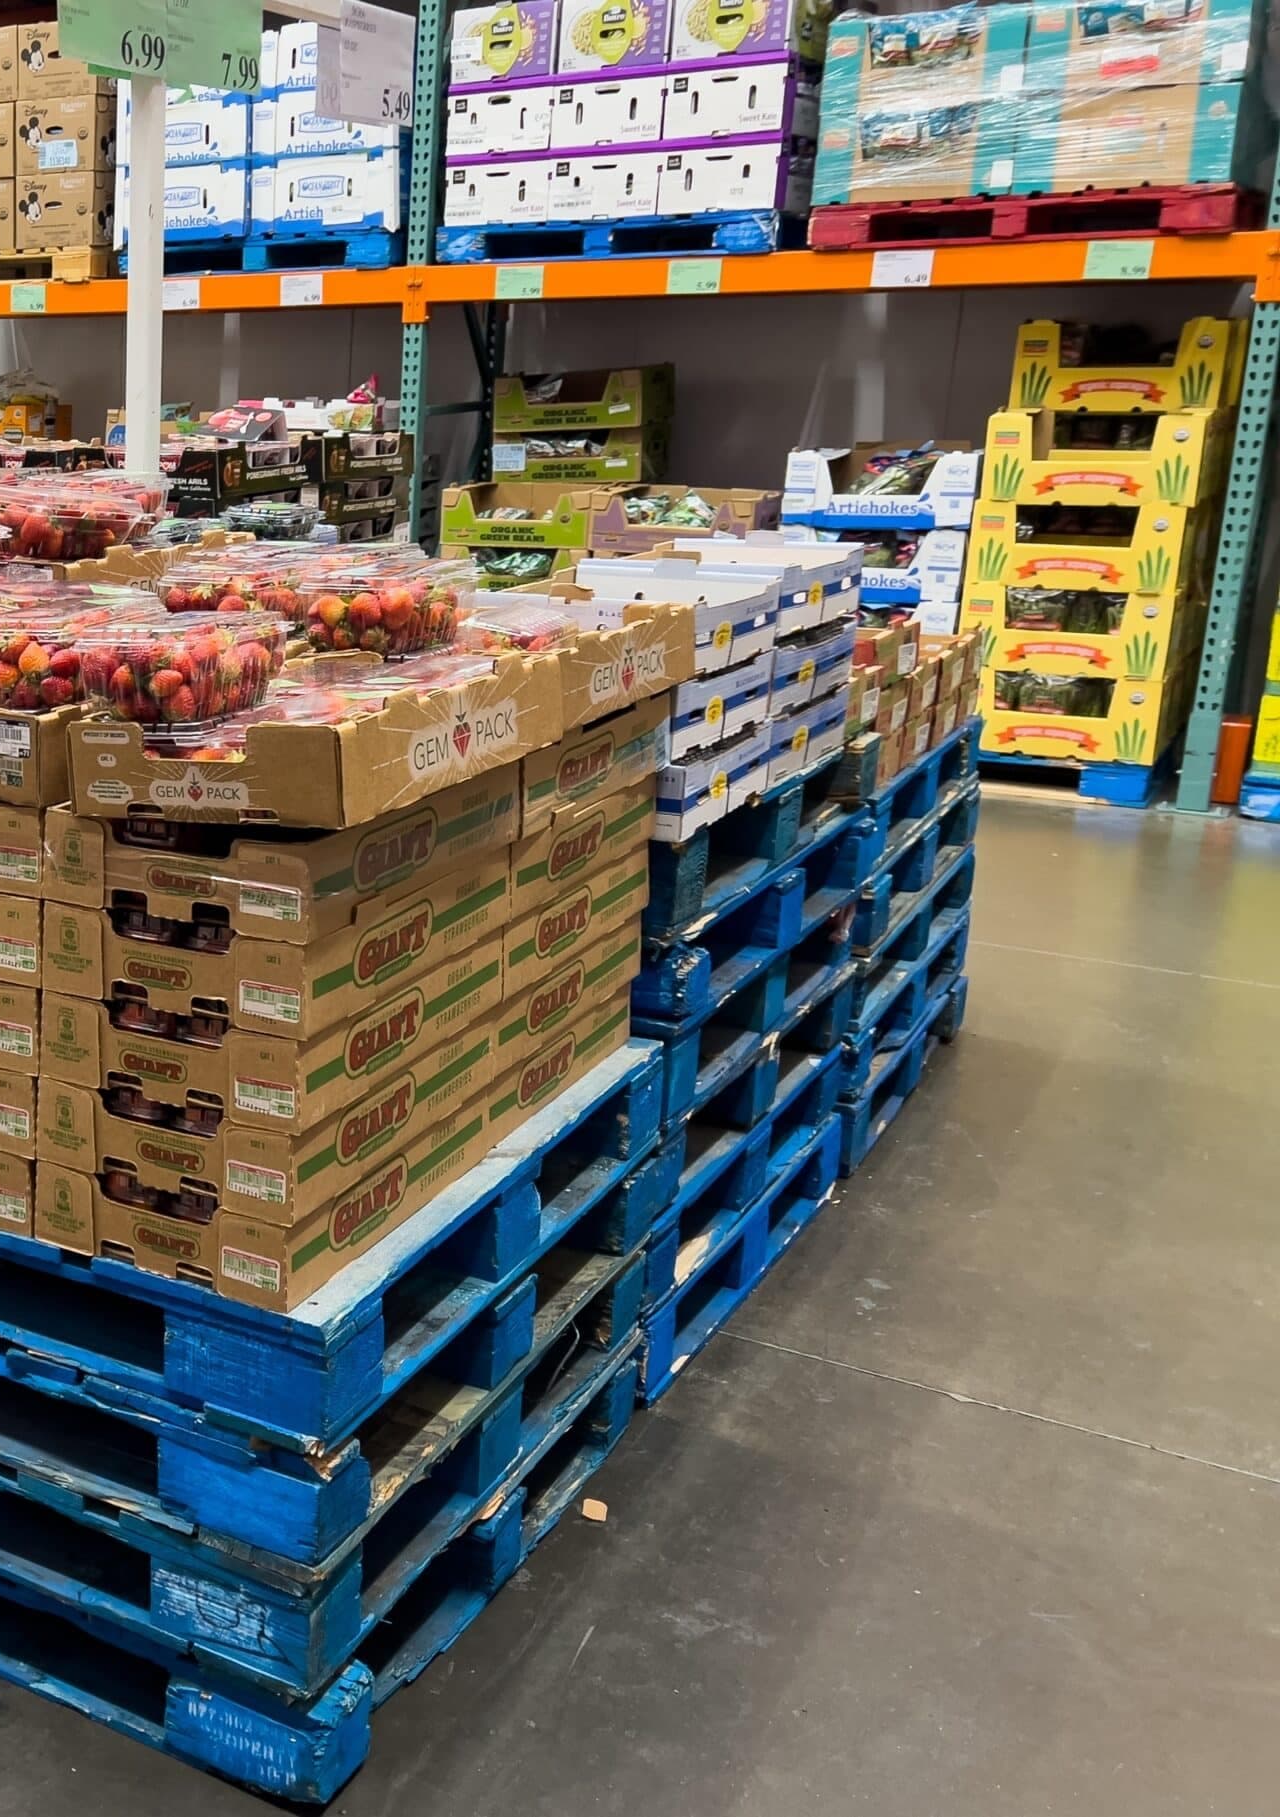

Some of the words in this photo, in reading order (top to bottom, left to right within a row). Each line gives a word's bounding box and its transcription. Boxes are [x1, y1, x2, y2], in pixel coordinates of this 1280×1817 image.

[121, 30, 165, 71] 6.99
[222, 53, 259, 89] 7.99
[382, 89, 410, 120] 5.49
[285, 140, 352, 154] Artichokes
[533, 417, 563, 426] GREEN
[566, 416, 598, 425] BEANS
[543, 408, 587, 417] ORGANIC
[532, 471, 562, 480] GREEN
[564, 470, 597, 479] BEANS
[542, 463, 586, 472] ORGANIC
[827, 502, 918, 515] Artichokes
[480, 534, 510, 543] GREEN
[512, 534, 545, 543] BEANS
[491, 526, 535, 535] ORGANIC
[593, 664, 618, 693] GEM
[637, 649, 664, 676] PACK
[414, 735, 450, 770] GEM
[476, 709, 514, 745] PACK
[560, 743, 613, 791] GIANT
[156, 786, 184, 798] GEM
[207, 787, 240, 800] PACK
[551, 822, 602, 877] GIANT
[539, 895, 590, 952] GIANT
[358, 916, 430, 981] GIANT
[127, 961, 187, 988] GIANT
[529, 971, 581, 1029] GIANT
[349, 1004, 420, 1072] GIANT
[123, 1053, 182, 1081] GIANT
[521, 1041, 572, 1104] GIANT
[341, 1086, 412, 1159] GIANT
[140, 1143, 200, 1170] GIANT
[333, 1164, 403, 1243] GIANT
[137, 1227, 196, 1257] GIANT
